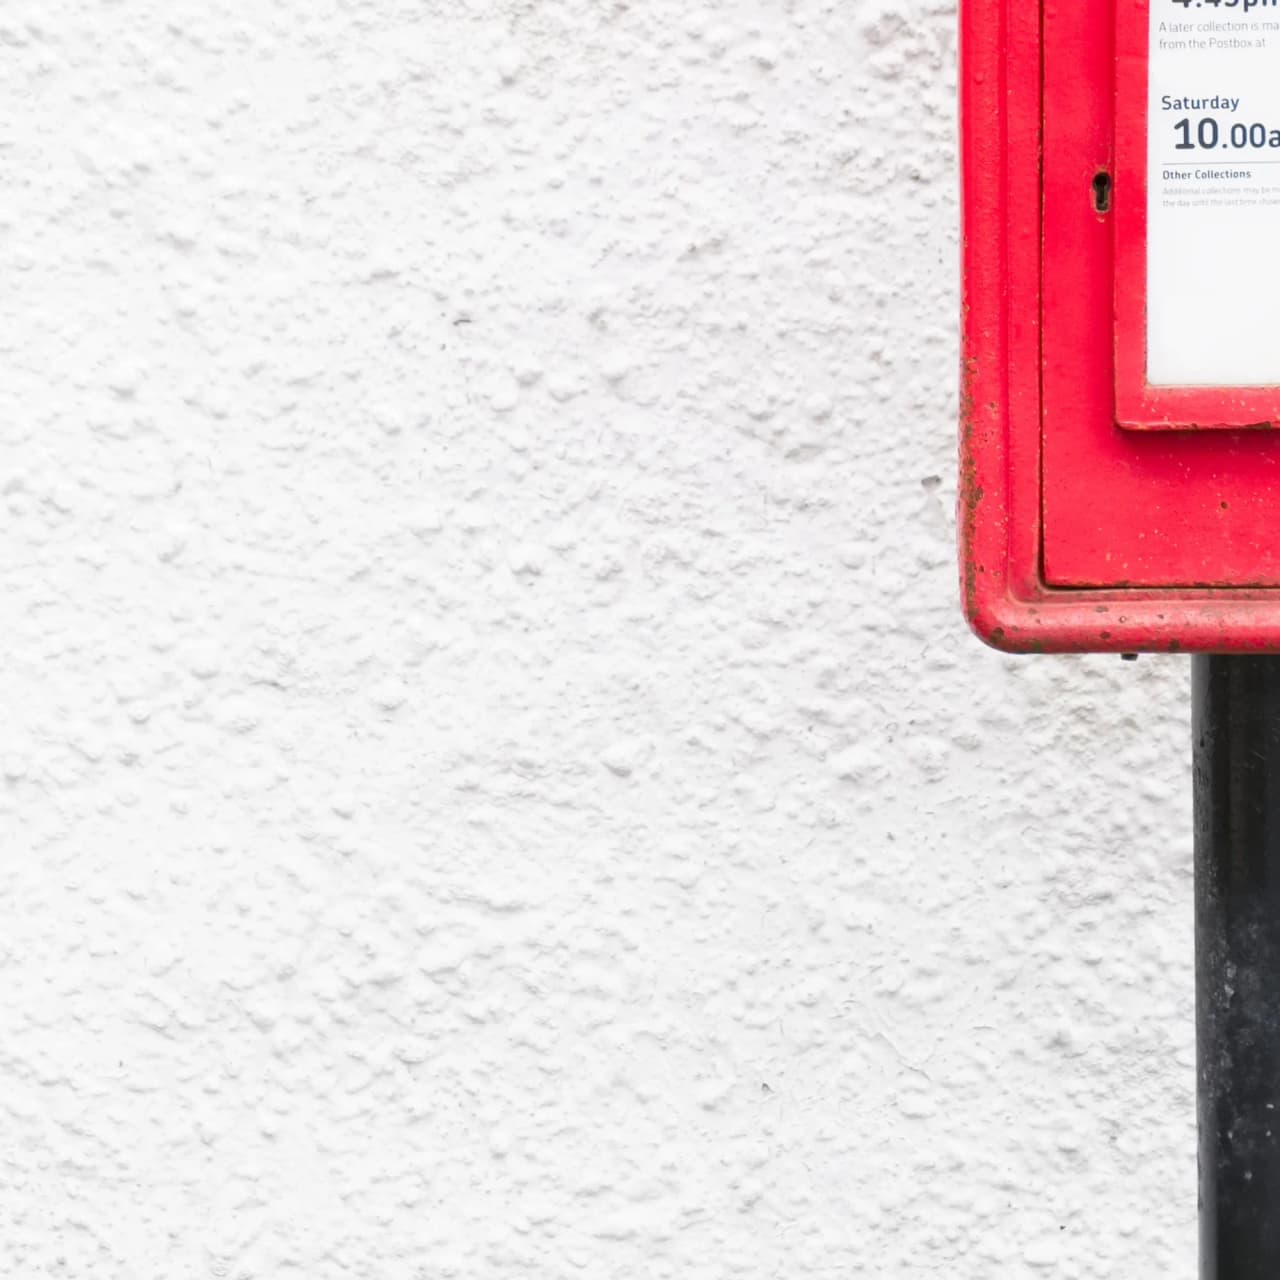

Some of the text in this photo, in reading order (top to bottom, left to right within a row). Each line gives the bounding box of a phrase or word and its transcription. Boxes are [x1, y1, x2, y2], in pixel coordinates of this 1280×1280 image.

[1159, 22, 1166, 32] A
[1169, 21, 1193, 32] later
[1197, 21, 1248, 32] collection
[1251, 23, 1259, 31] is
[1160, 37, 1265, 49] from the Postbox at
[1162, 96, 1239, 112] Saturday
[1163, 169, 1251, 180] Other Collections
